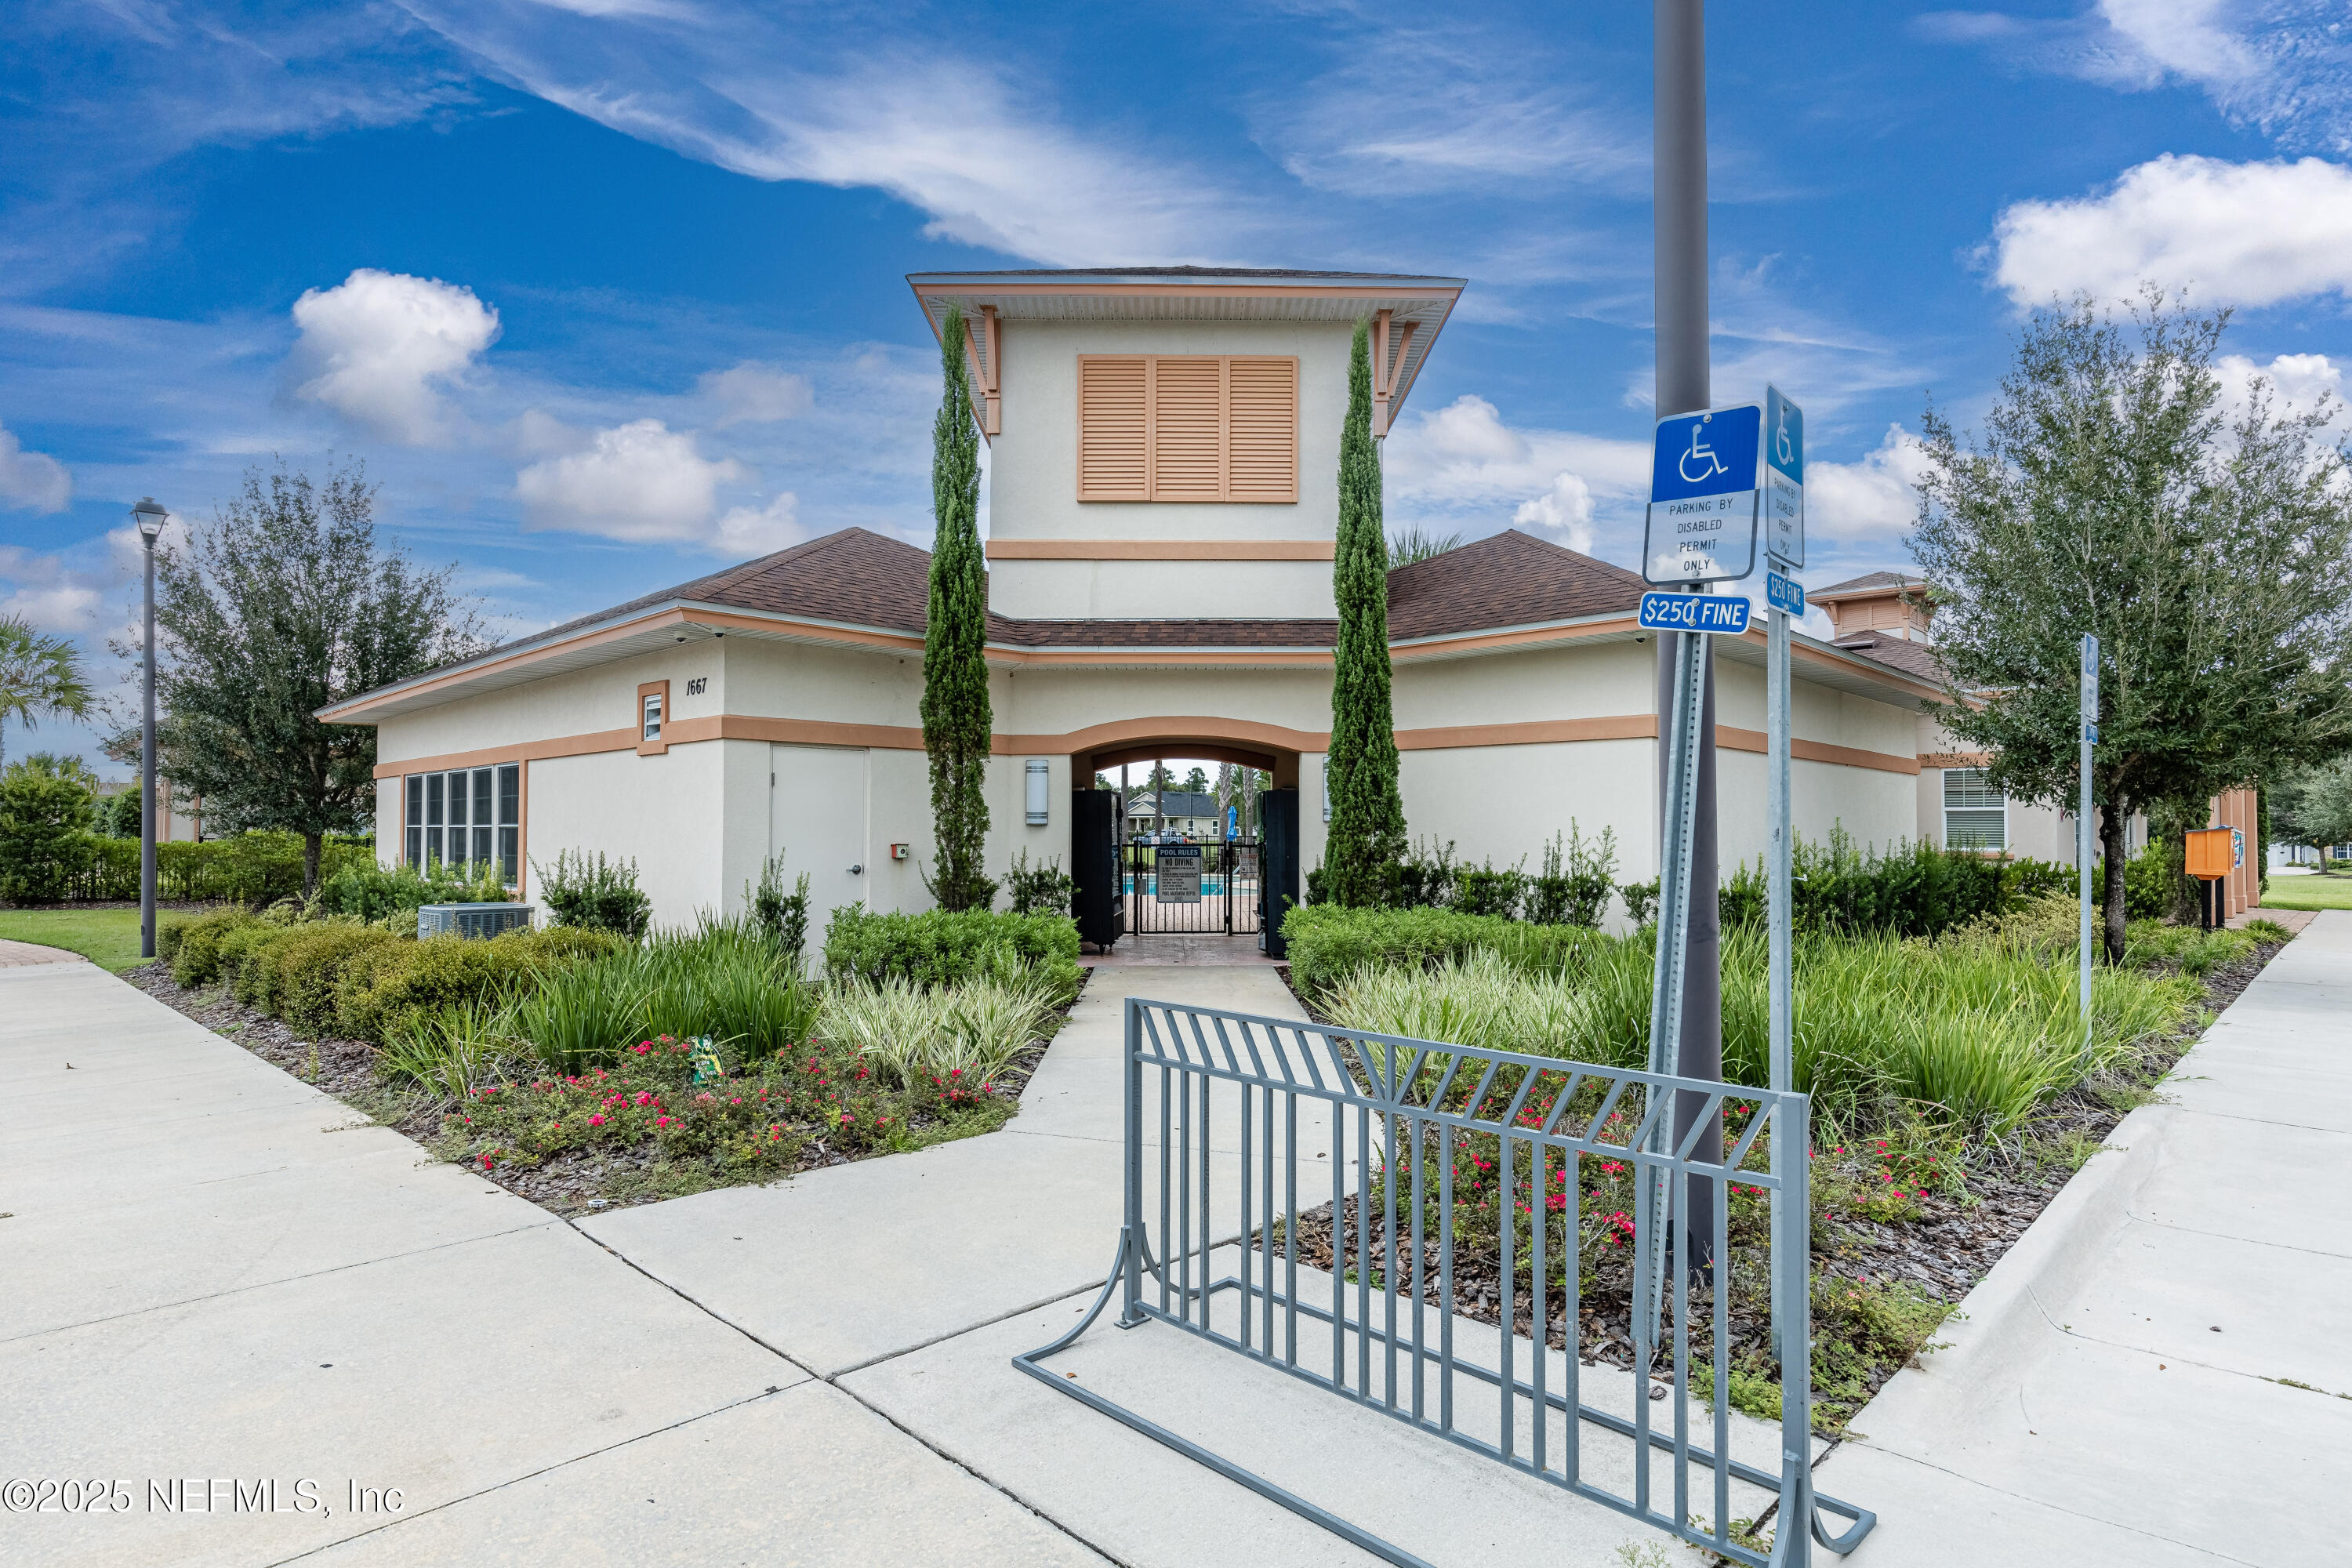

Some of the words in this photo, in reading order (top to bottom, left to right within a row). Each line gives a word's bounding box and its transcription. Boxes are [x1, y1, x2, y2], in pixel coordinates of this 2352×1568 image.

[1669, 501, 1711, 516] PARKING
[1719, 498, 1733, 510] BY
[1776, 498, 1795, 517] DISABLED
[1677, 519, 1722, 534] DISABLED
[1679, 539, 1717, 553] PERMIT
[1683, 559, 1711, 572] ONLY
[1770, 575, 1786, 600] $250
[1788, 583, 1801, 606] FINE
[1644, 597, 1695, 624] $250
[1700, 603, 1745, 626] FINE
[686, 677, 707, 696] 1667
[1165, 858, 1173, 866] NO
[1174, 858, 1193, 866] DIVING
